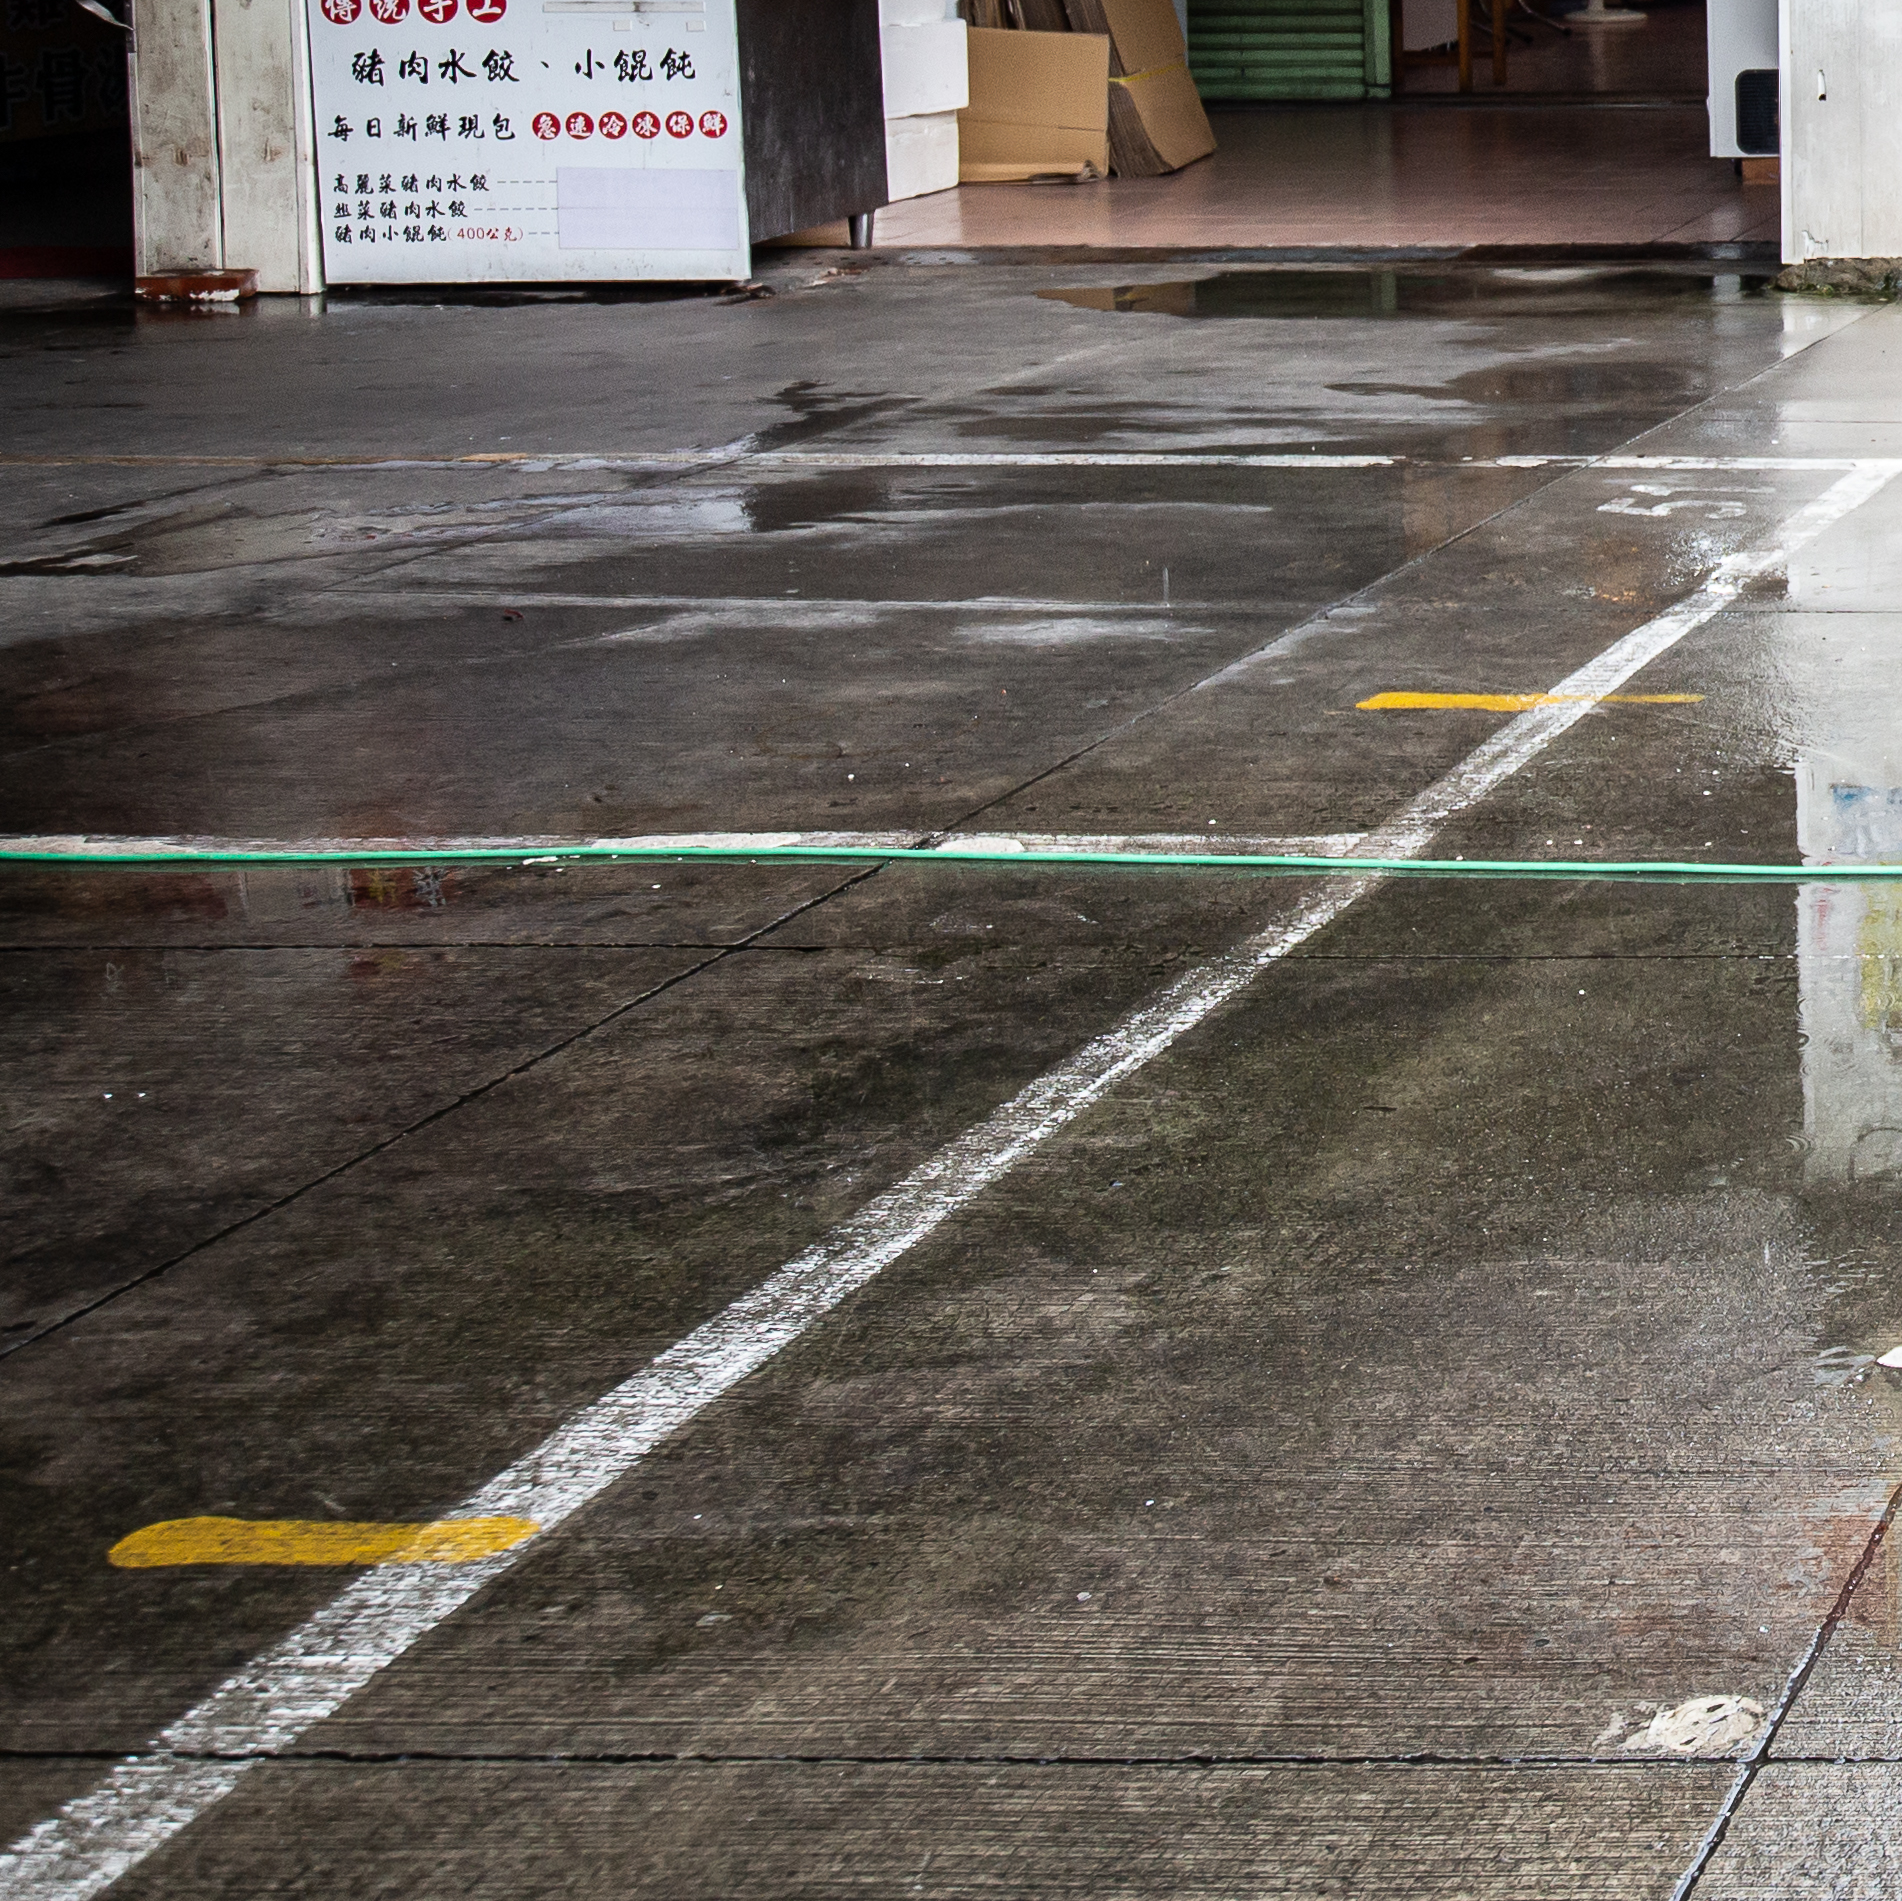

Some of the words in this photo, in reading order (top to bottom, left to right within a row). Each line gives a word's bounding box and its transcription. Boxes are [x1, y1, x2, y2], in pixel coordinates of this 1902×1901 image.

[327, 114, 517, 142] 每日新鮮現包
[333, 173, 491, 195] 高麗菜豬肉水餃
[333, 200, 469, 220] 韭菜豬肉水餃
